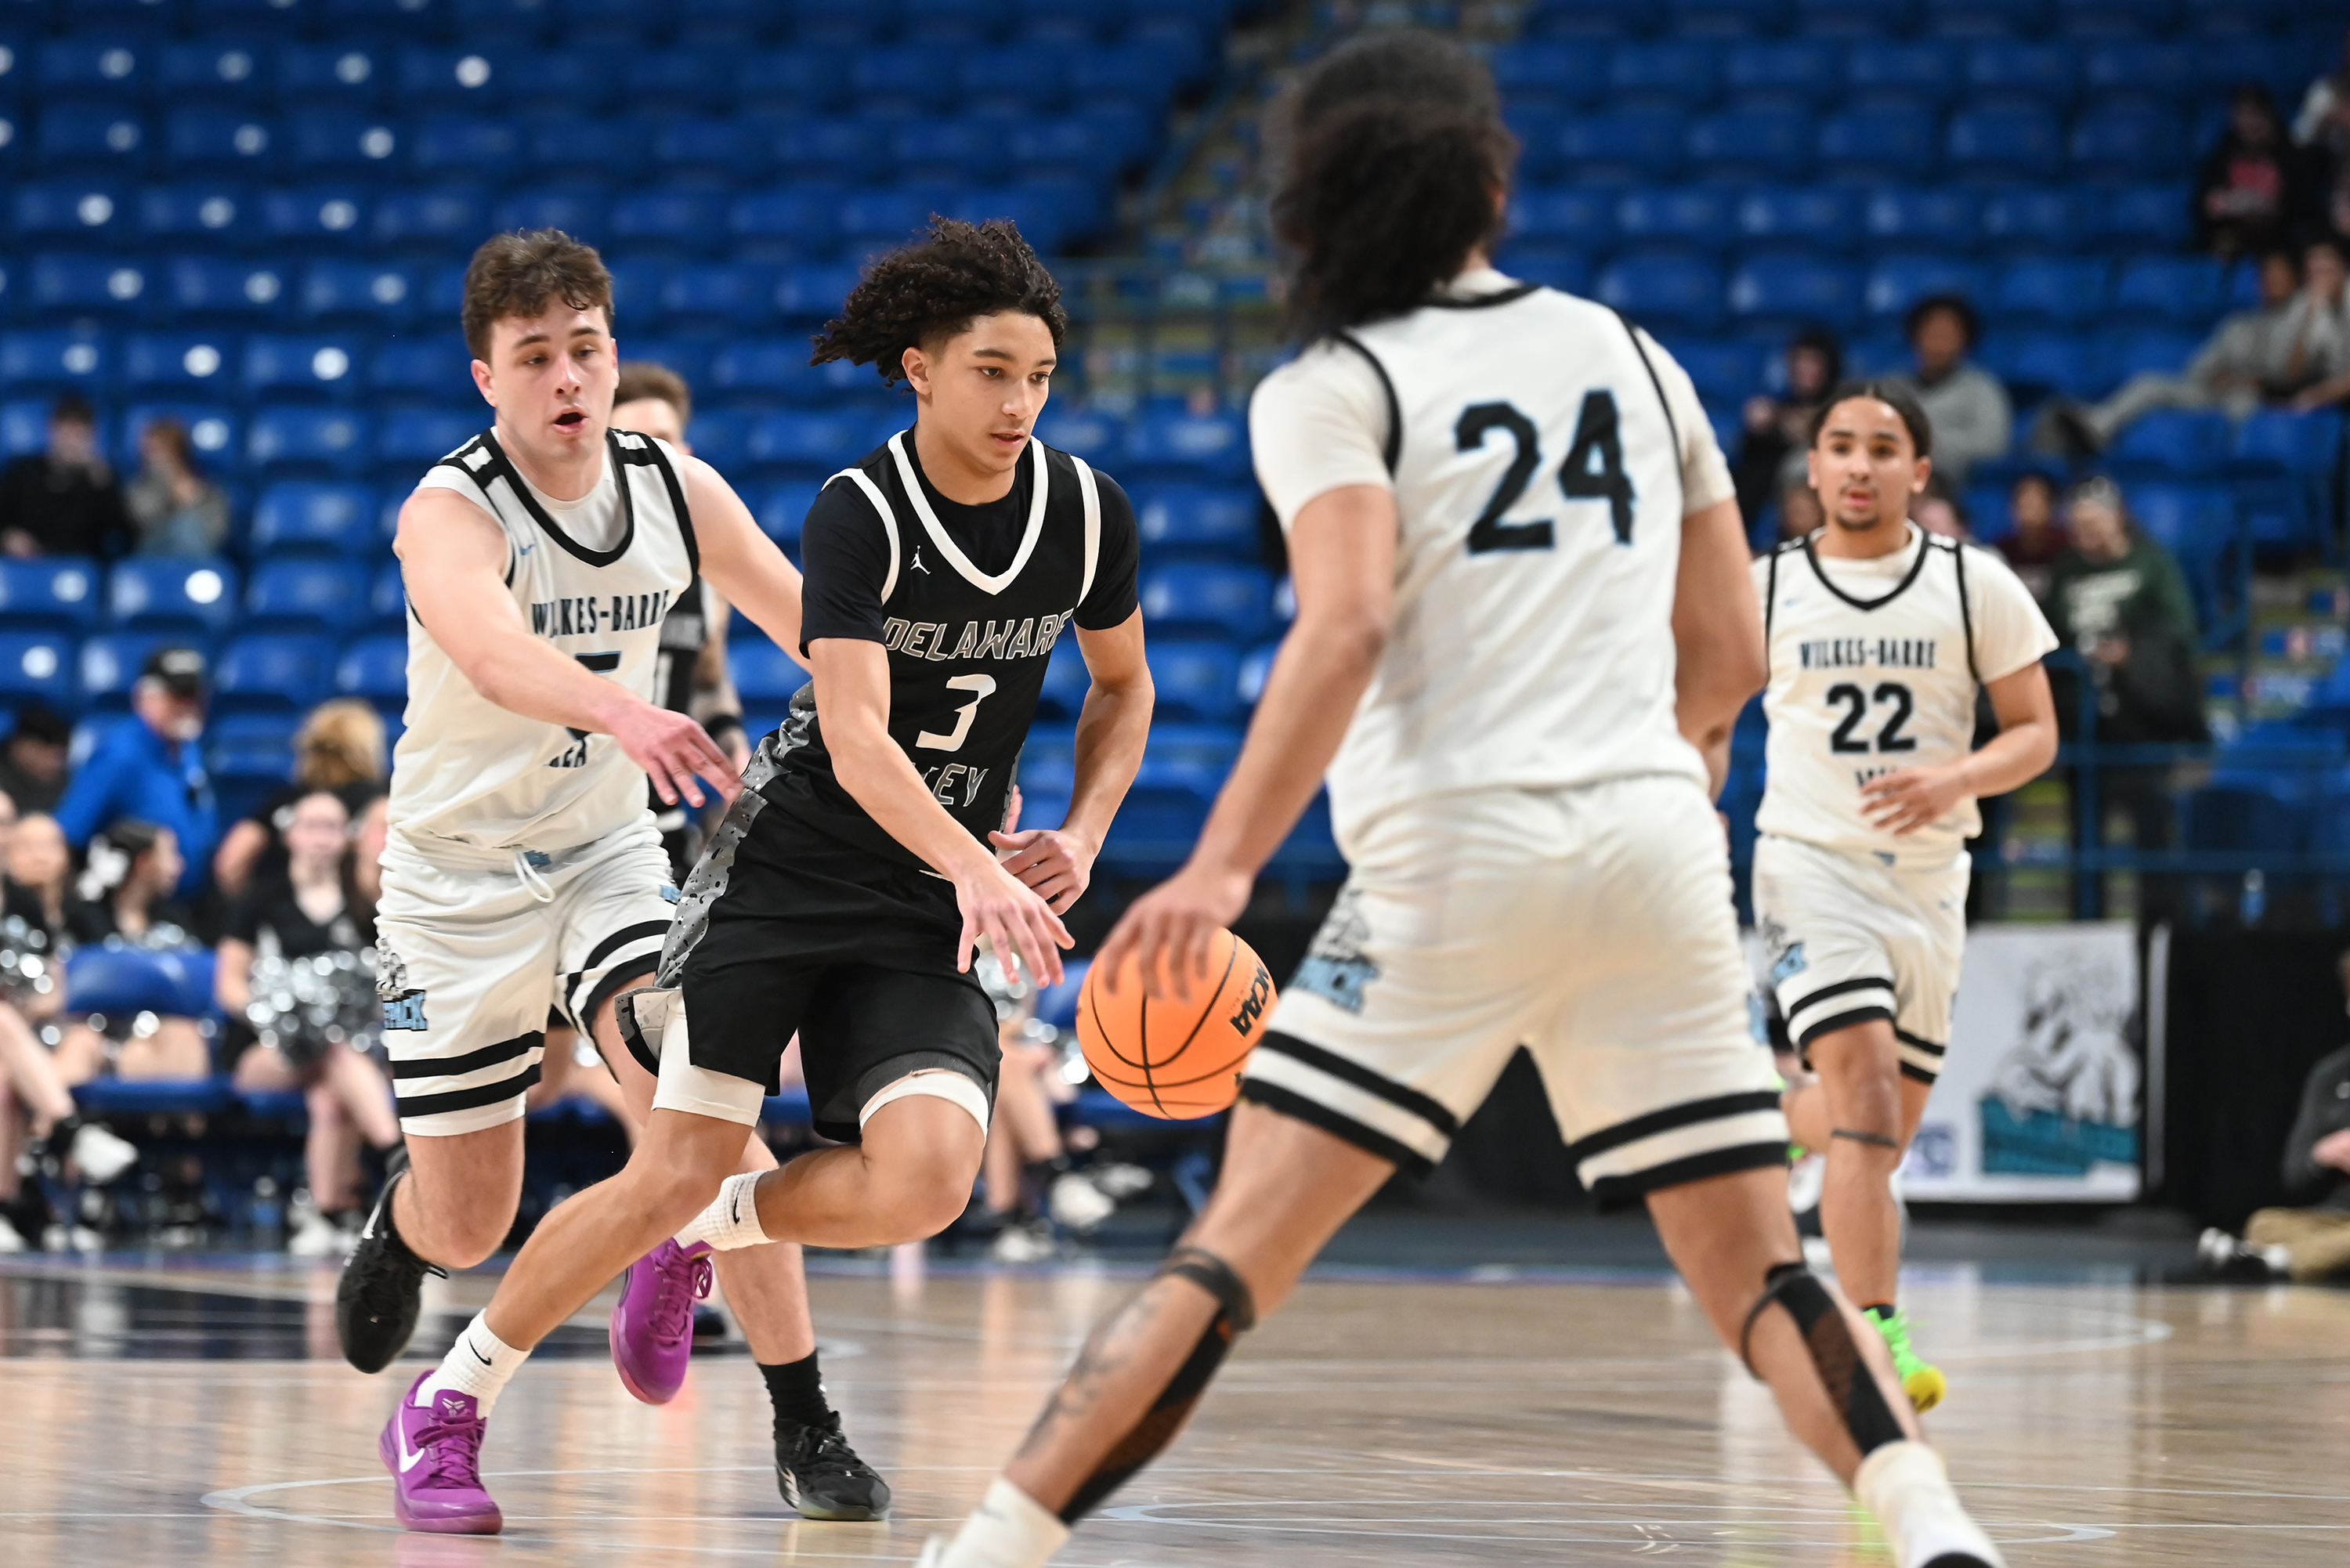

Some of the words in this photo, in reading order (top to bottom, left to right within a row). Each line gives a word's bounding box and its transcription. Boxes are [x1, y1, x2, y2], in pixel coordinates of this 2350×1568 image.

[1455, 388, 1636, 556] 24
[1799, 637, 1935, 670] WILKES-BARRE
[916, 674, 996, 752] 3
[1827, 682, 1916, 753] 22
[1230, 960, 1269, 1038] NCAA
